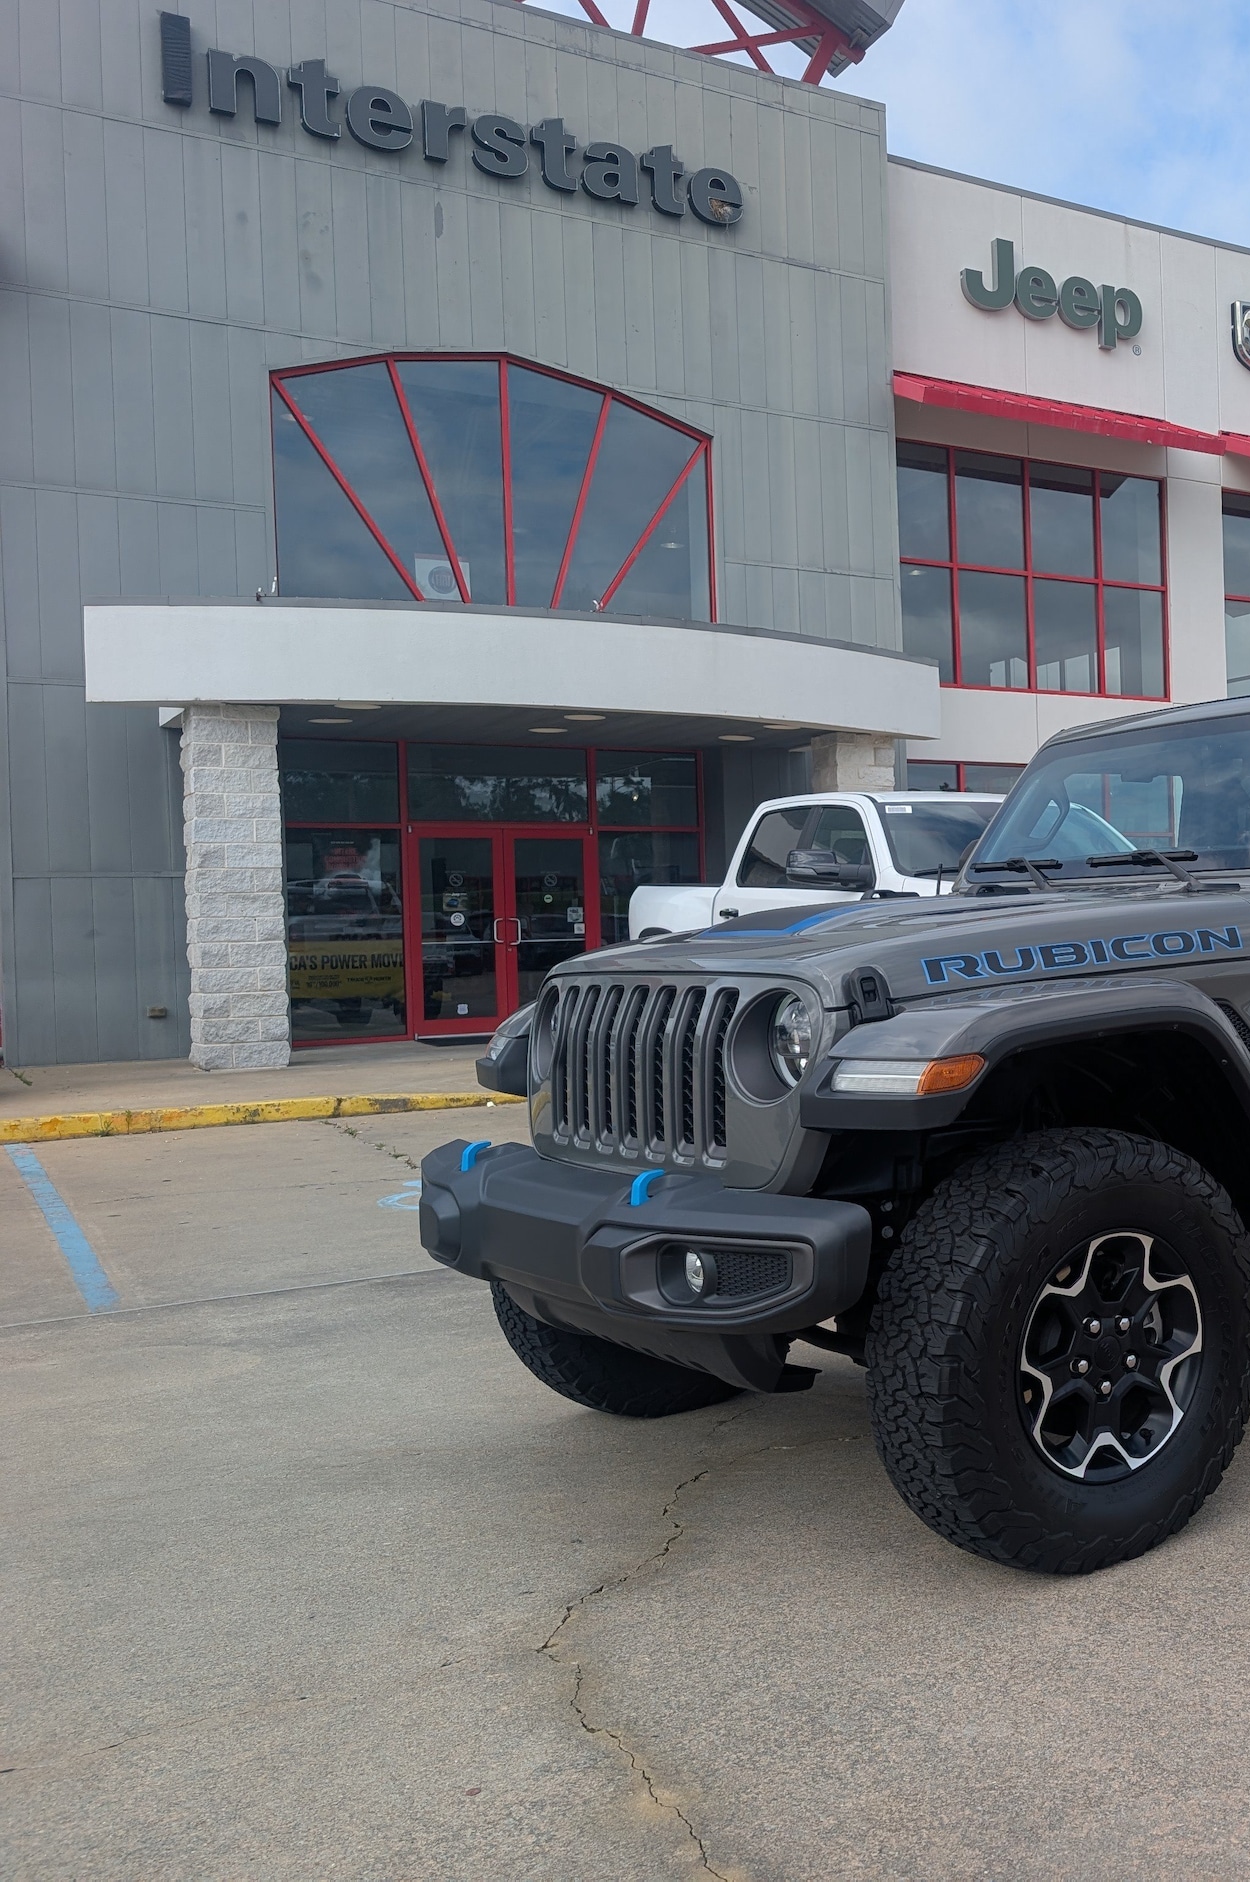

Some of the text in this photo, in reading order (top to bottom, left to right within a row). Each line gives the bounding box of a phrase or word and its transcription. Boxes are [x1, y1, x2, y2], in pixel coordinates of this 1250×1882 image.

[160, 11, 745, 226] Interstate
[960, 237, 1143, 351] Jeep
[321, 954, 368, 970] POWER
[920, 926, 1244, 985] RUBICON
